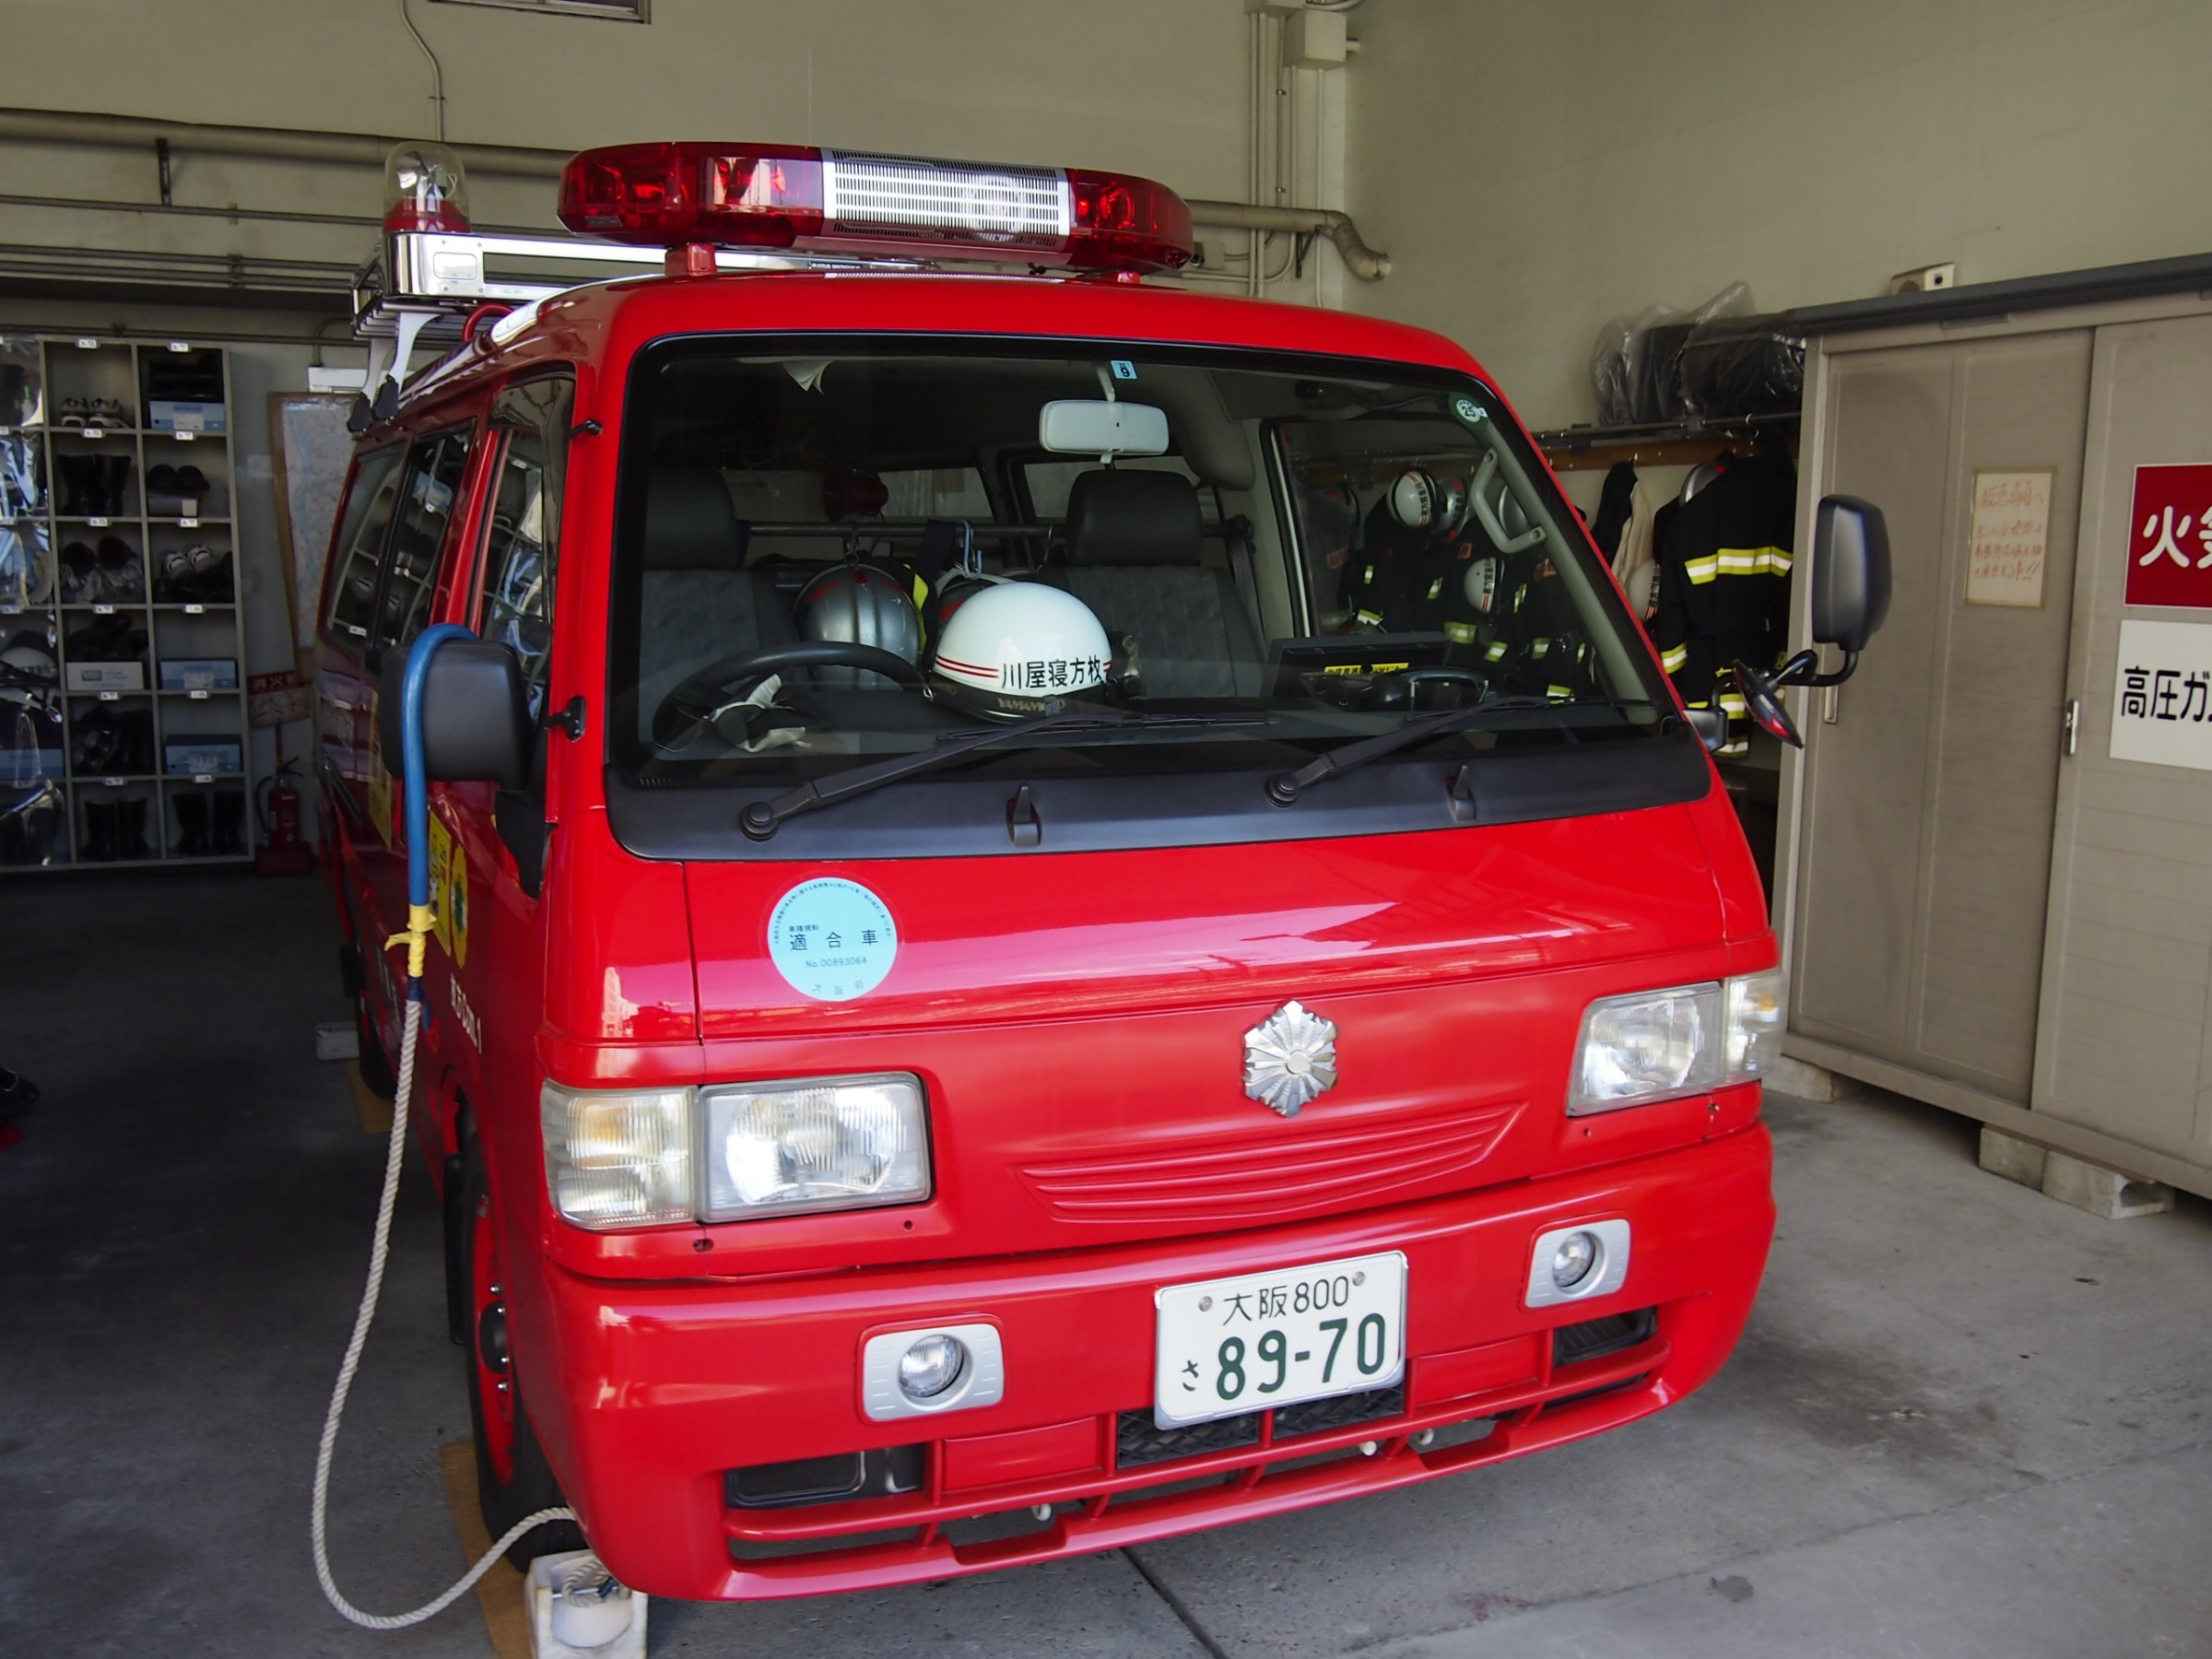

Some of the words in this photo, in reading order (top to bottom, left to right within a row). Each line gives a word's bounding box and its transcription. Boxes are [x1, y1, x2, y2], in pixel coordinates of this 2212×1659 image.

[2122, 665, 2212, 723] 高圧ガ
[1182, 1359, 1199, 1392] さ
[1217, 1312, 1385, 1400] 89-70
